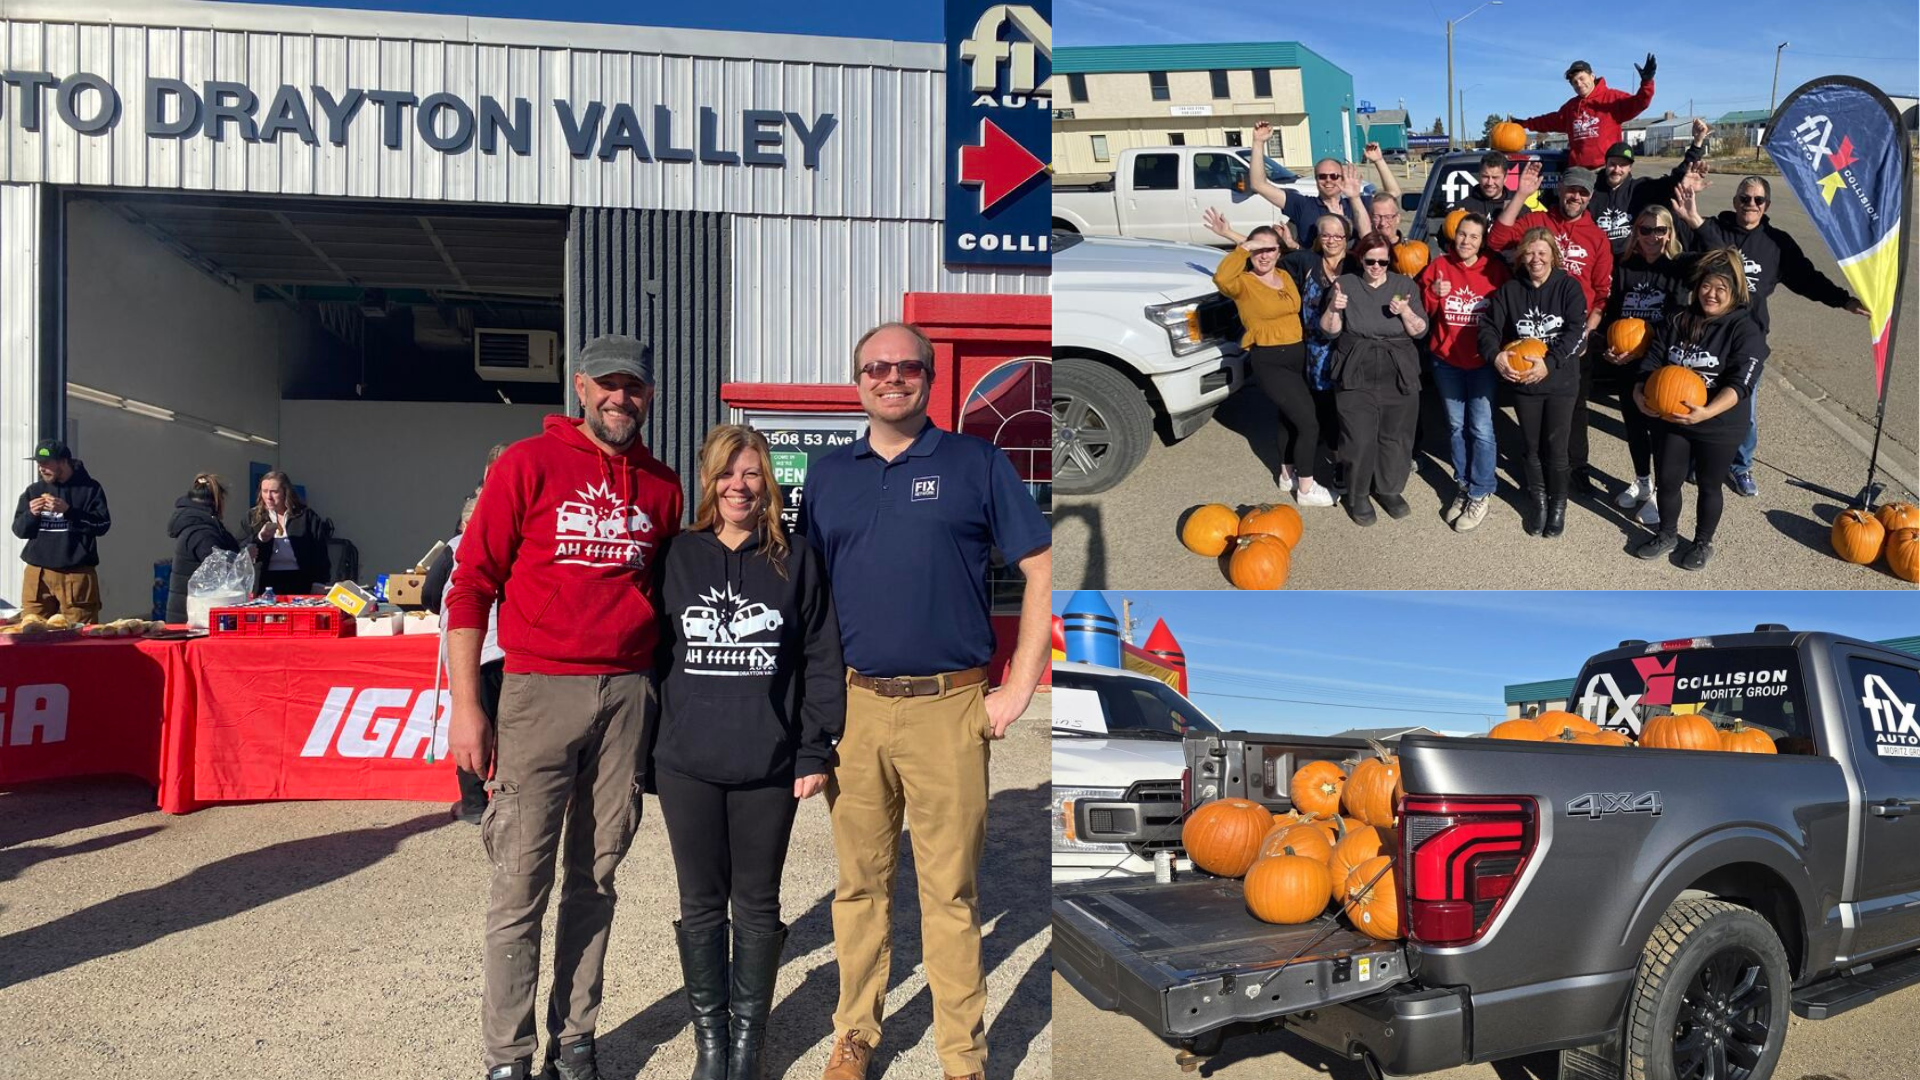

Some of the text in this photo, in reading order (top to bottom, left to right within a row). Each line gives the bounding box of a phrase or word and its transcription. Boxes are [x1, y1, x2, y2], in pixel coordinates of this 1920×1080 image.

[971, 94, 1052, 110] AUT
[0, 70, 838, 169] TO DRAYTON VALLEY
[1790, 130, 1813, 161] AUTO
[1844, 169, 1879, 221] COLLISION
[957, 233, 1052, 252] COLLI
[804, 433, 822, 445] 53
[827, 433, 853, 445] Ave
[774, 467, 804, 483] PEN
[915, 480, 936, 493] FIX
[555, 543, 581, 556] AH
[685, 649, 702, 664] AH
[1677, 669, 1788, 690] COLLISION
[1701, 685, 1788, 700] MORITZ GROUP
[0, 683, 70, 747] A
[300, 686, 452, 760] IGA
[1876, 733, 1919, 745] AUTO
[1883, 746, 1908, 755] MORITZ
